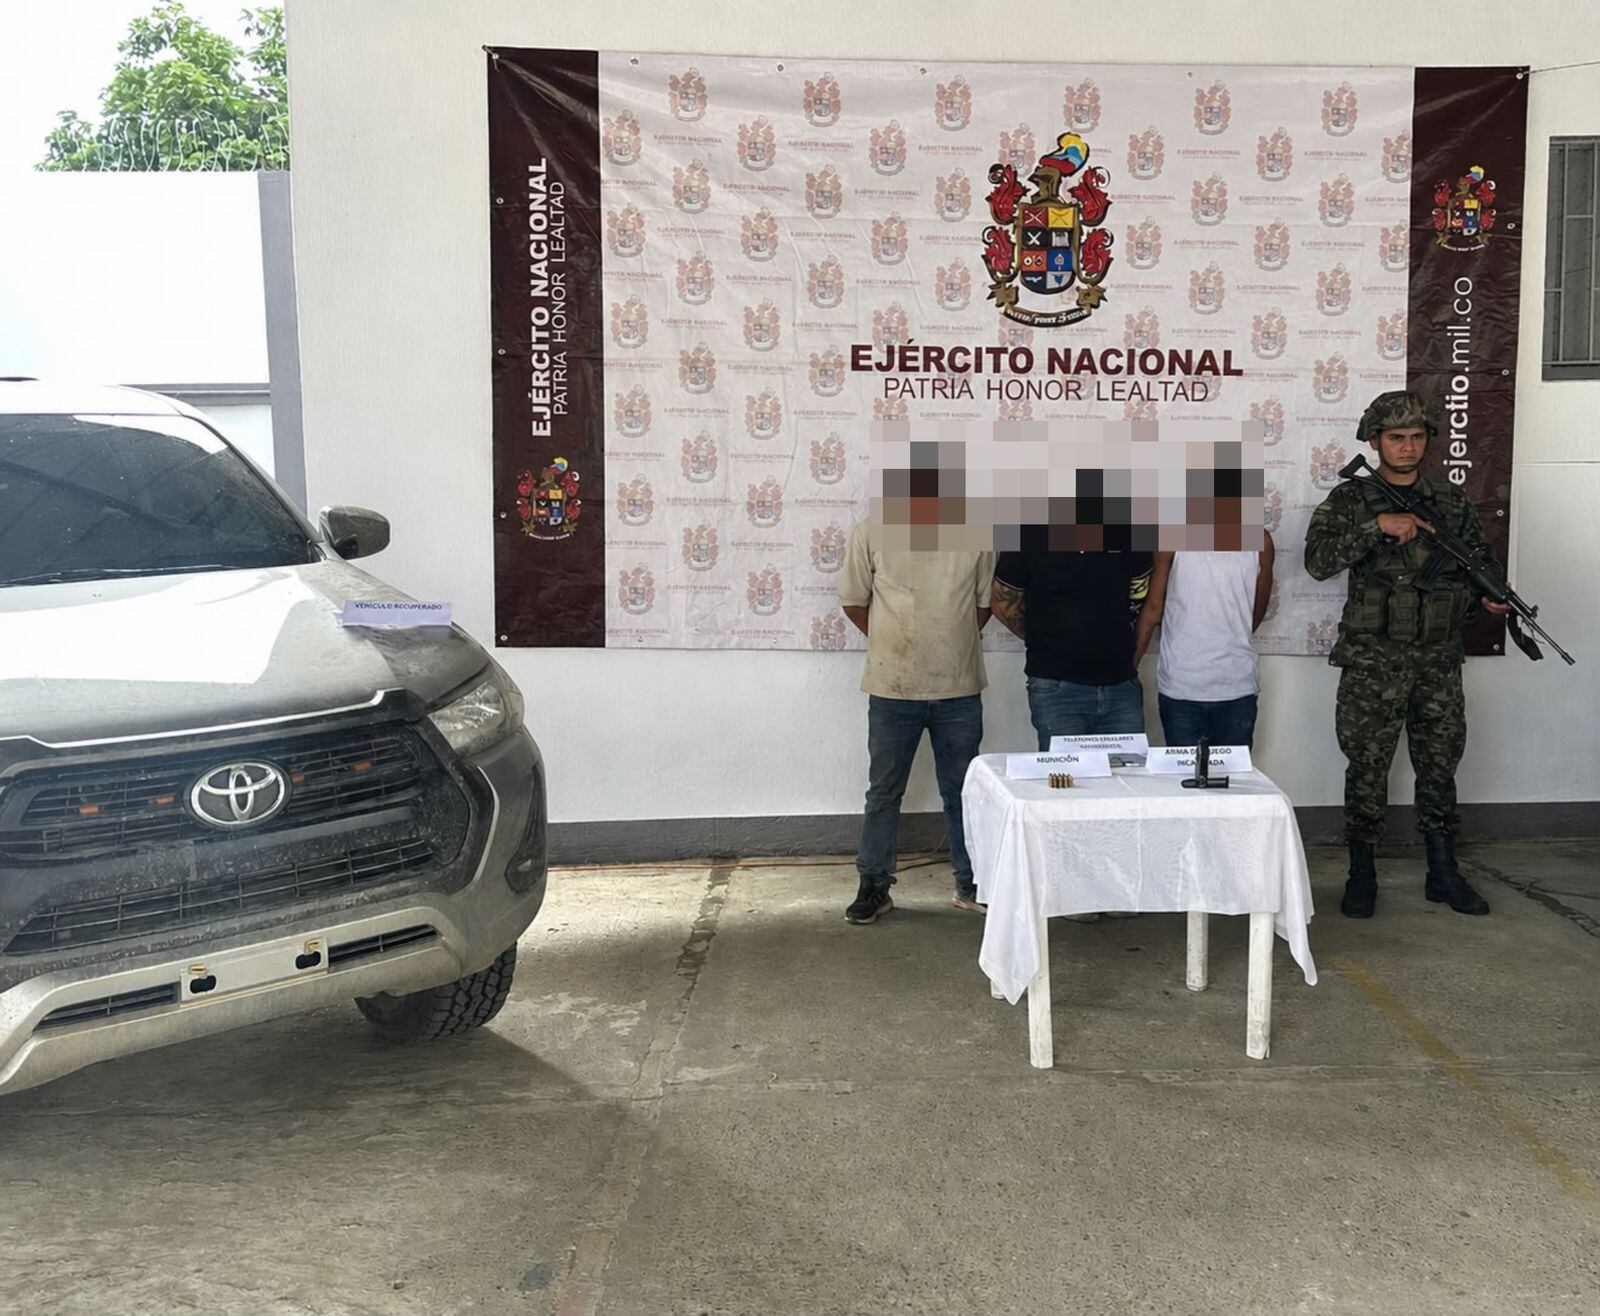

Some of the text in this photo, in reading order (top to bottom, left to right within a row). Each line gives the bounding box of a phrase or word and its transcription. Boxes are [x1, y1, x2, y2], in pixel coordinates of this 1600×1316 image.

[528, 157, 551, 437] EJÉRCITO NACIONAL
[549, 181, 568, 415] PATRIA HONOR LEALTAD
[850, 338, 1243, 377] EJÉRCITO NACIONAL
[884, 377, 1209, 402] PATRIA HONOR LEALTAD
[1036, 755, 1079, 763] MUNICIÓN
